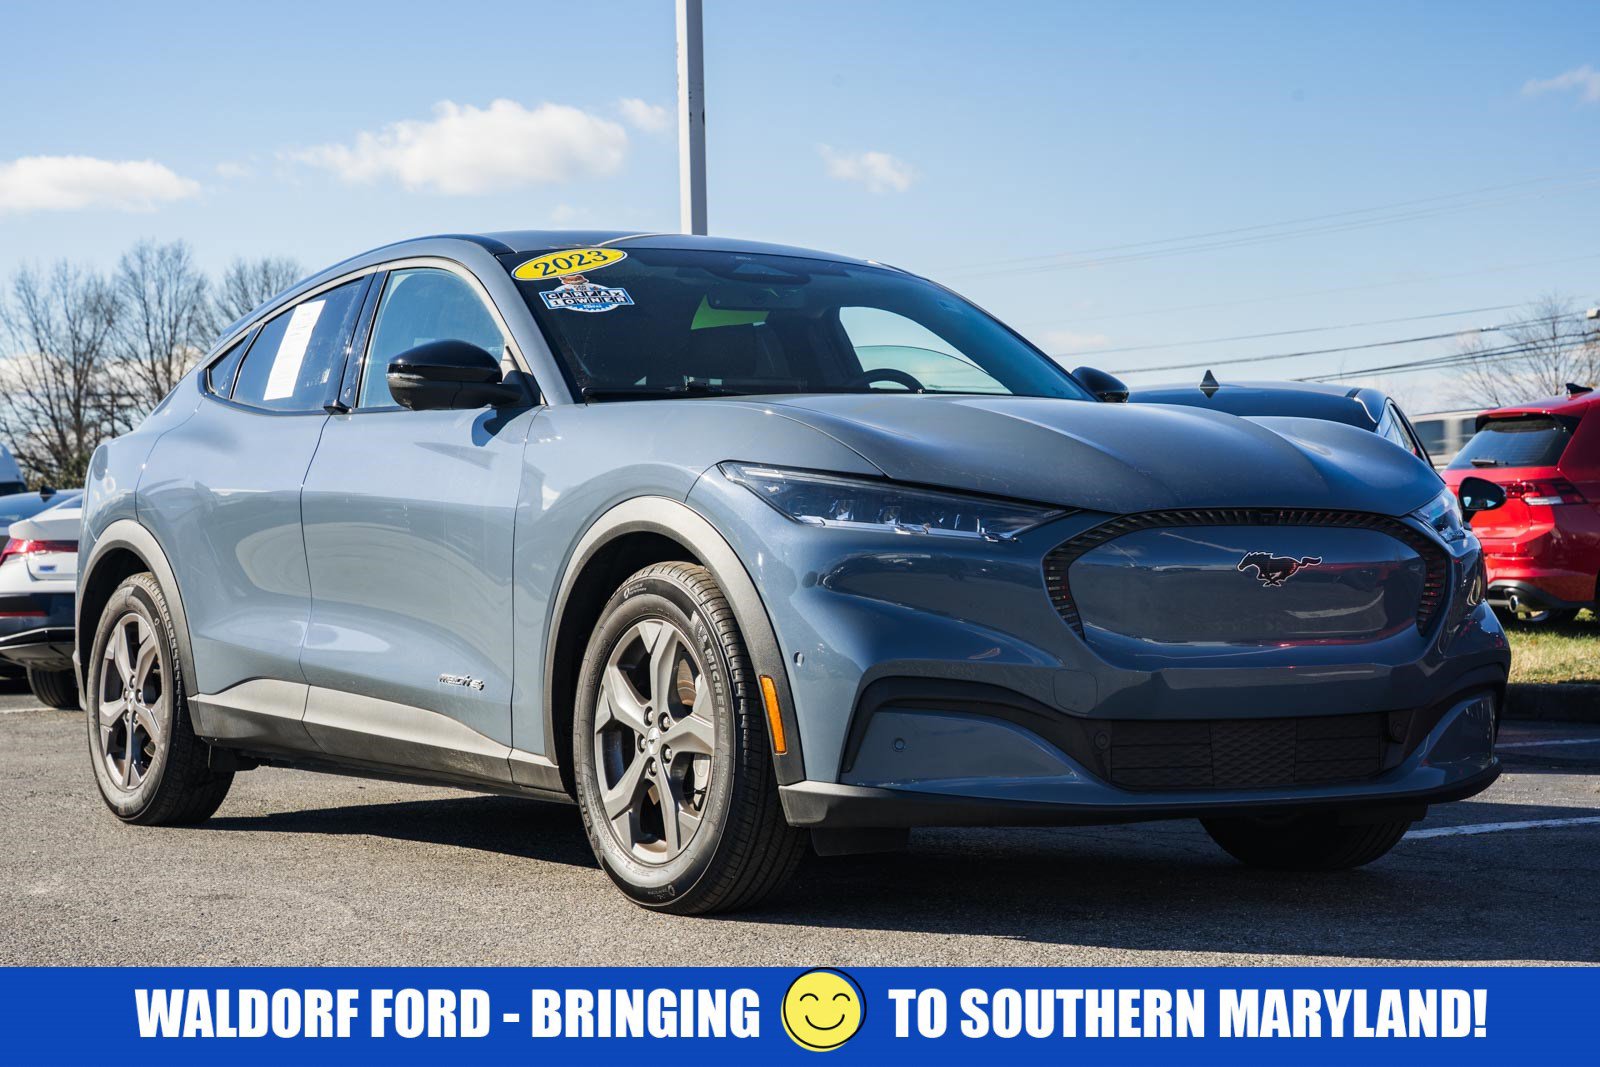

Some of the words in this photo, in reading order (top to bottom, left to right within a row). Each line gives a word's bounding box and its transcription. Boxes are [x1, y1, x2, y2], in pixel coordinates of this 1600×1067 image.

[534, 250, 608, 276] 2023
[547, 290, 624, 299] CARFAX
[566, 297, 627, 305] OWNER
